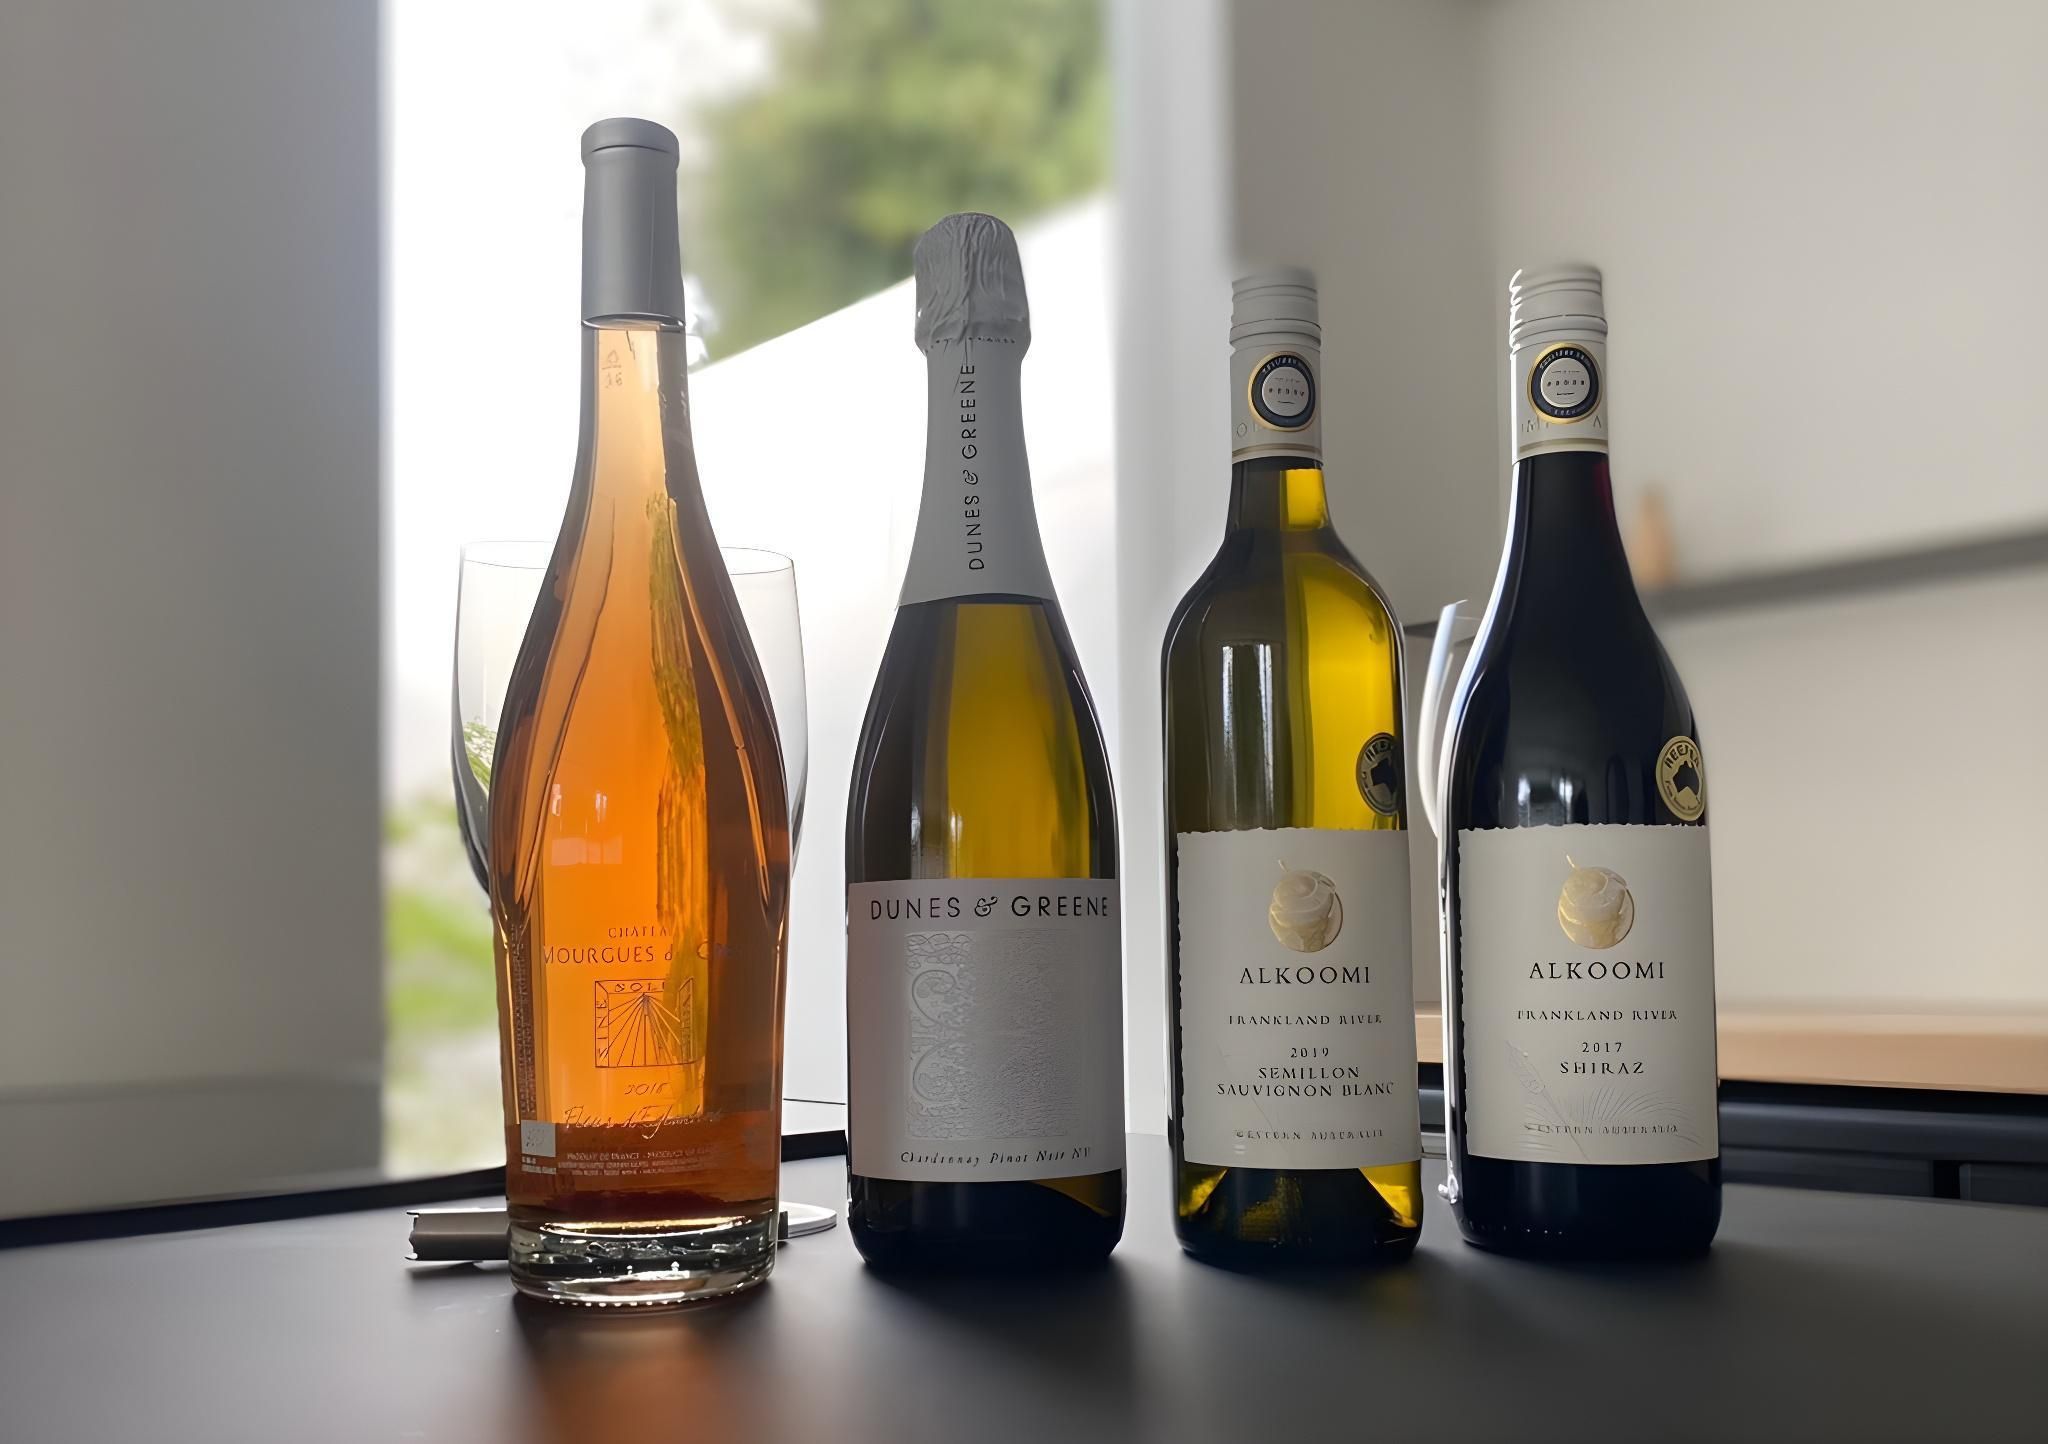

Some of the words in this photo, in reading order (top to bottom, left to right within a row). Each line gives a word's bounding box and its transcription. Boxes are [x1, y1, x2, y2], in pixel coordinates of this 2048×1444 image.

[959, 364, 978, 460] GREENE
[962, 469, 979, 486] &
[963, 495, 985, 571] DUNES
[870, 896, 961, 920] DUNES
[973, 895, 999, 918] &
[1010, 895, 1109, 918] GREENE
[1239, 966, 1371, 985] ALKOOMI
[1529, 960, 1665, 981] ALKOOMI
[1228, 1014, 1331, 1026] FRANKLAND
[1338, 1014, 1384, 1025] RIVER
[1517, 1009, 1623, 1022] FRANKLAND
[1632, 1009, 1680, 1021] RIVER
[1290, 1047, 1330, 1059] 2019
[1581, 1041, 1623, 1054] 2017
[1258, 1066, 1360, 1080] SEMILLON
[1559, 1061, 1645, 1075] SHIRAZ
[1216, 1083, 1333, 1098] SAUVIGNON
[1342, 1081, 1394, 1097] BLANC
[989, 1151, 1029, 1164] Pinot
